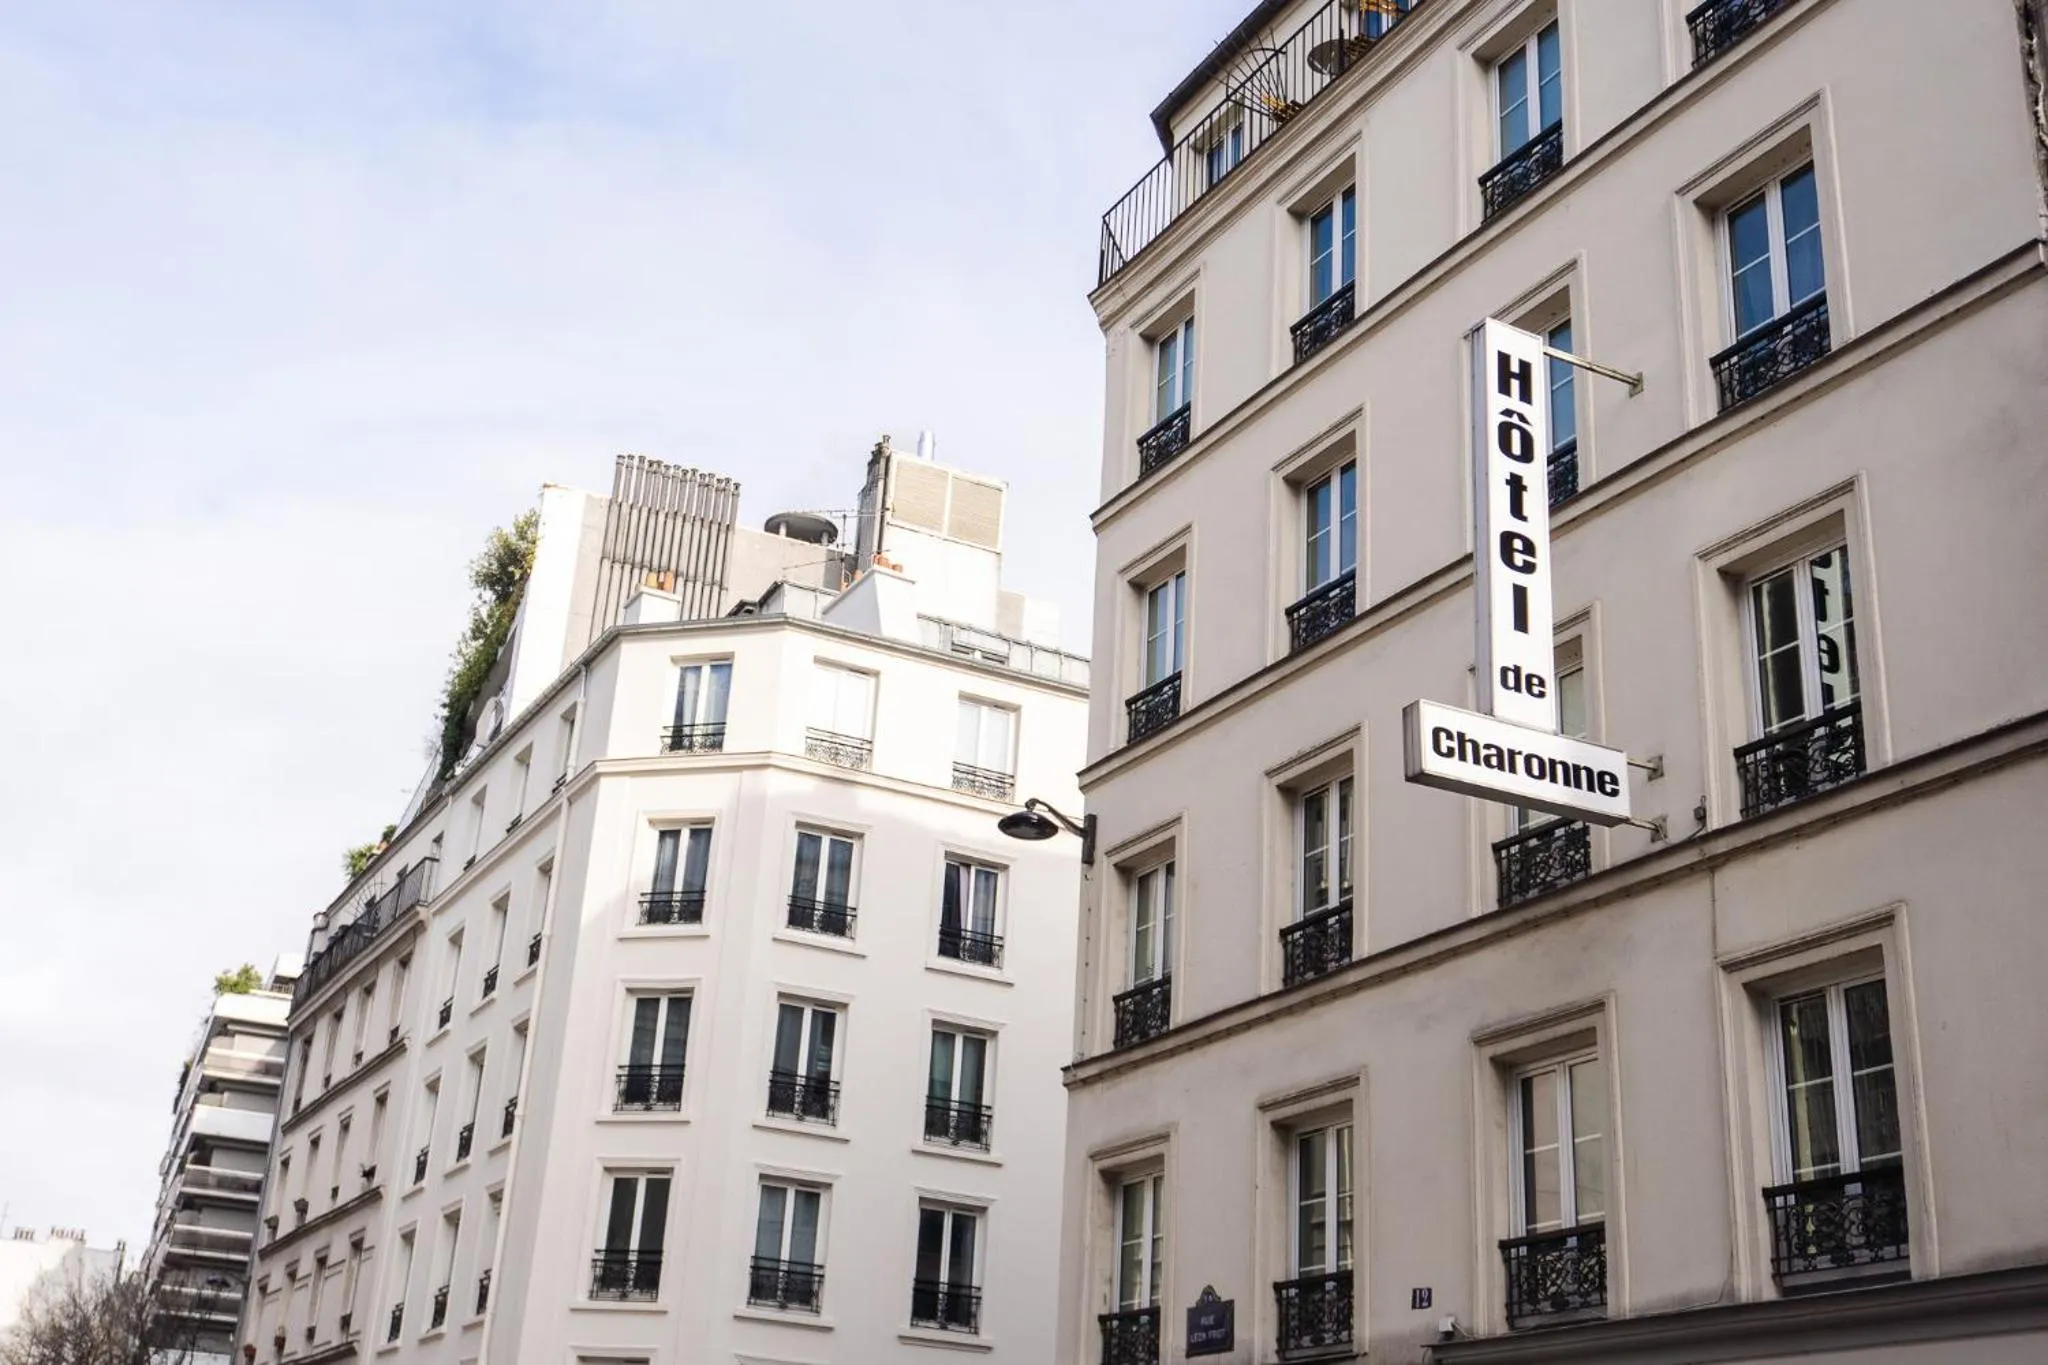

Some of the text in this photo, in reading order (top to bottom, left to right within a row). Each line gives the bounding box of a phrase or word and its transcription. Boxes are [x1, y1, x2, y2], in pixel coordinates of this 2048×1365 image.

[1497, 350, 1537, 634] Hôtel
[1500, 664, 1547, 699] de
[1432, 726, 1620, 798] Charonne
[1415, 1288, 1430, 1308] 12
